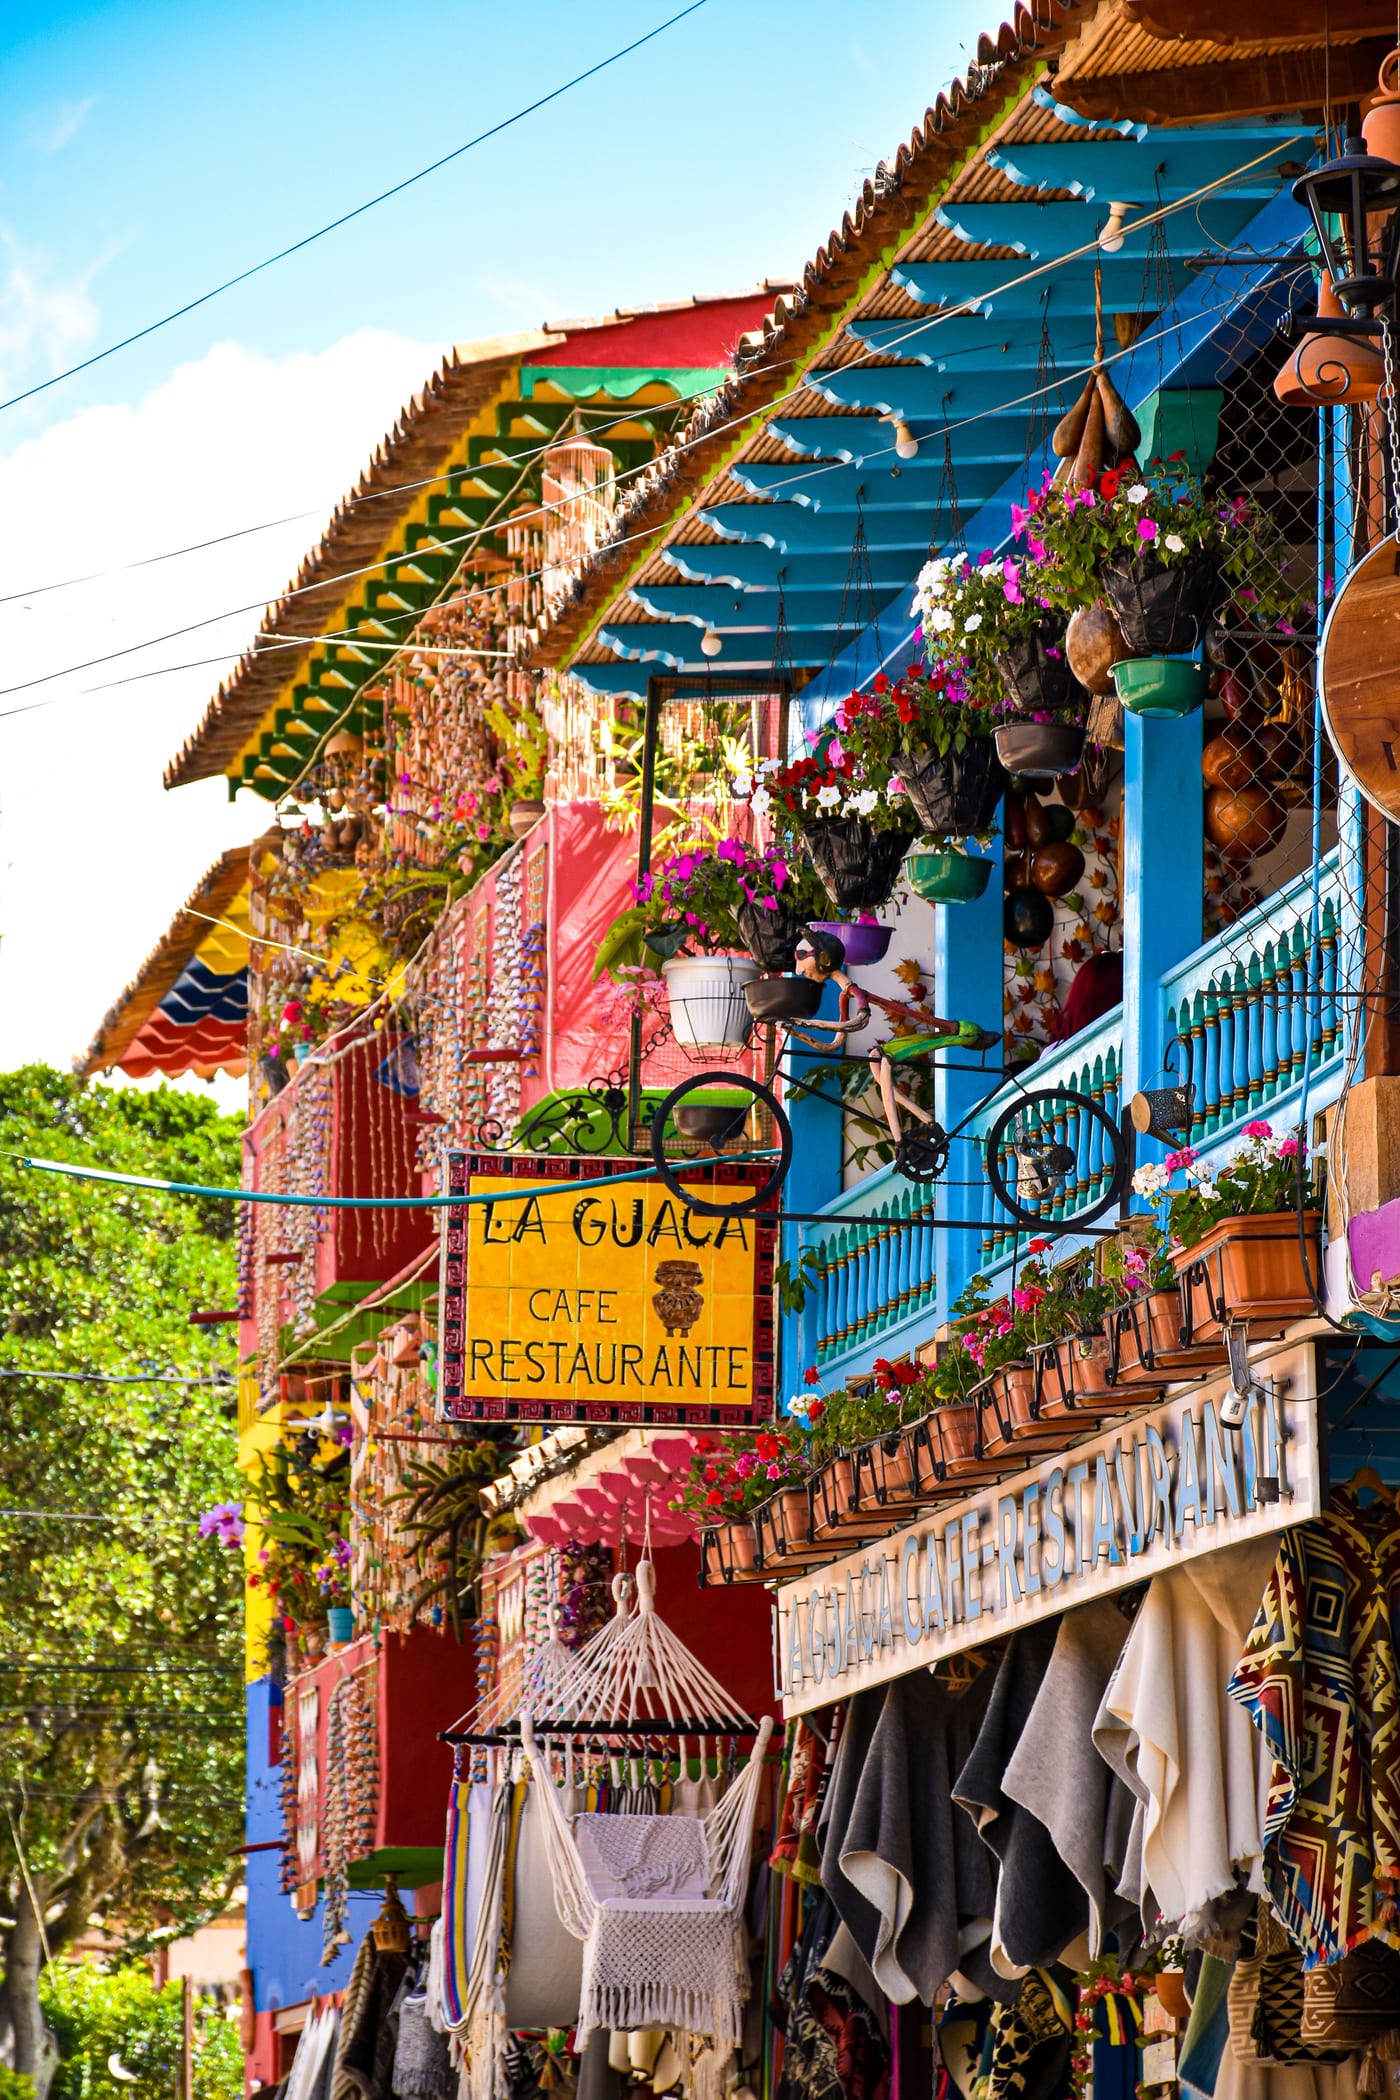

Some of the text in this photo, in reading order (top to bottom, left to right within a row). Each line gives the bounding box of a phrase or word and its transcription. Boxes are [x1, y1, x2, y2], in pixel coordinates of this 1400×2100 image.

[482, 1196, 749, 1251] LA GUACA
[529, 1288, 619, 1323] CAFE
[470, 1339, 748, 1389] RESTAURANTE
